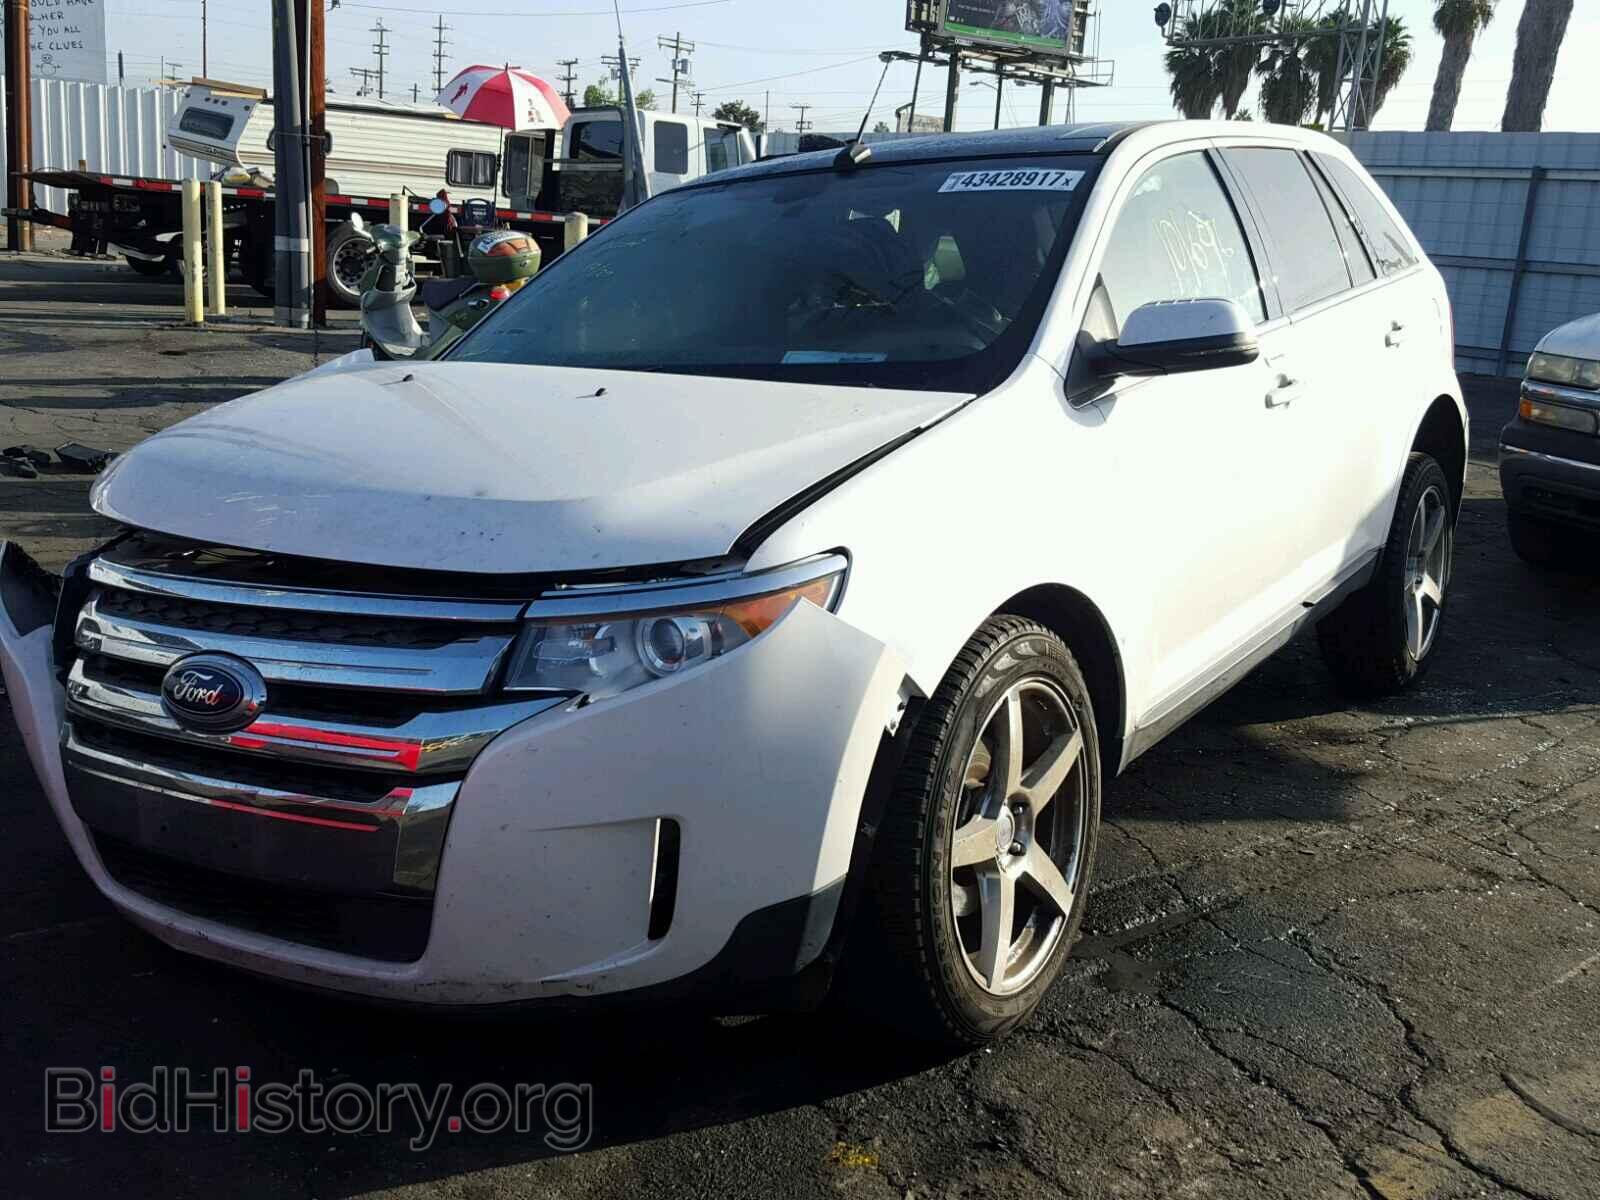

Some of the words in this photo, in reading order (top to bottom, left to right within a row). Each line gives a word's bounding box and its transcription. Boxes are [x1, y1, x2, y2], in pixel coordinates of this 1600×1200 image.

[64, 25, 81, 33] ALL
[49, 40, 84, 50] CLUES
[174, 670, 224, 706] Ford
